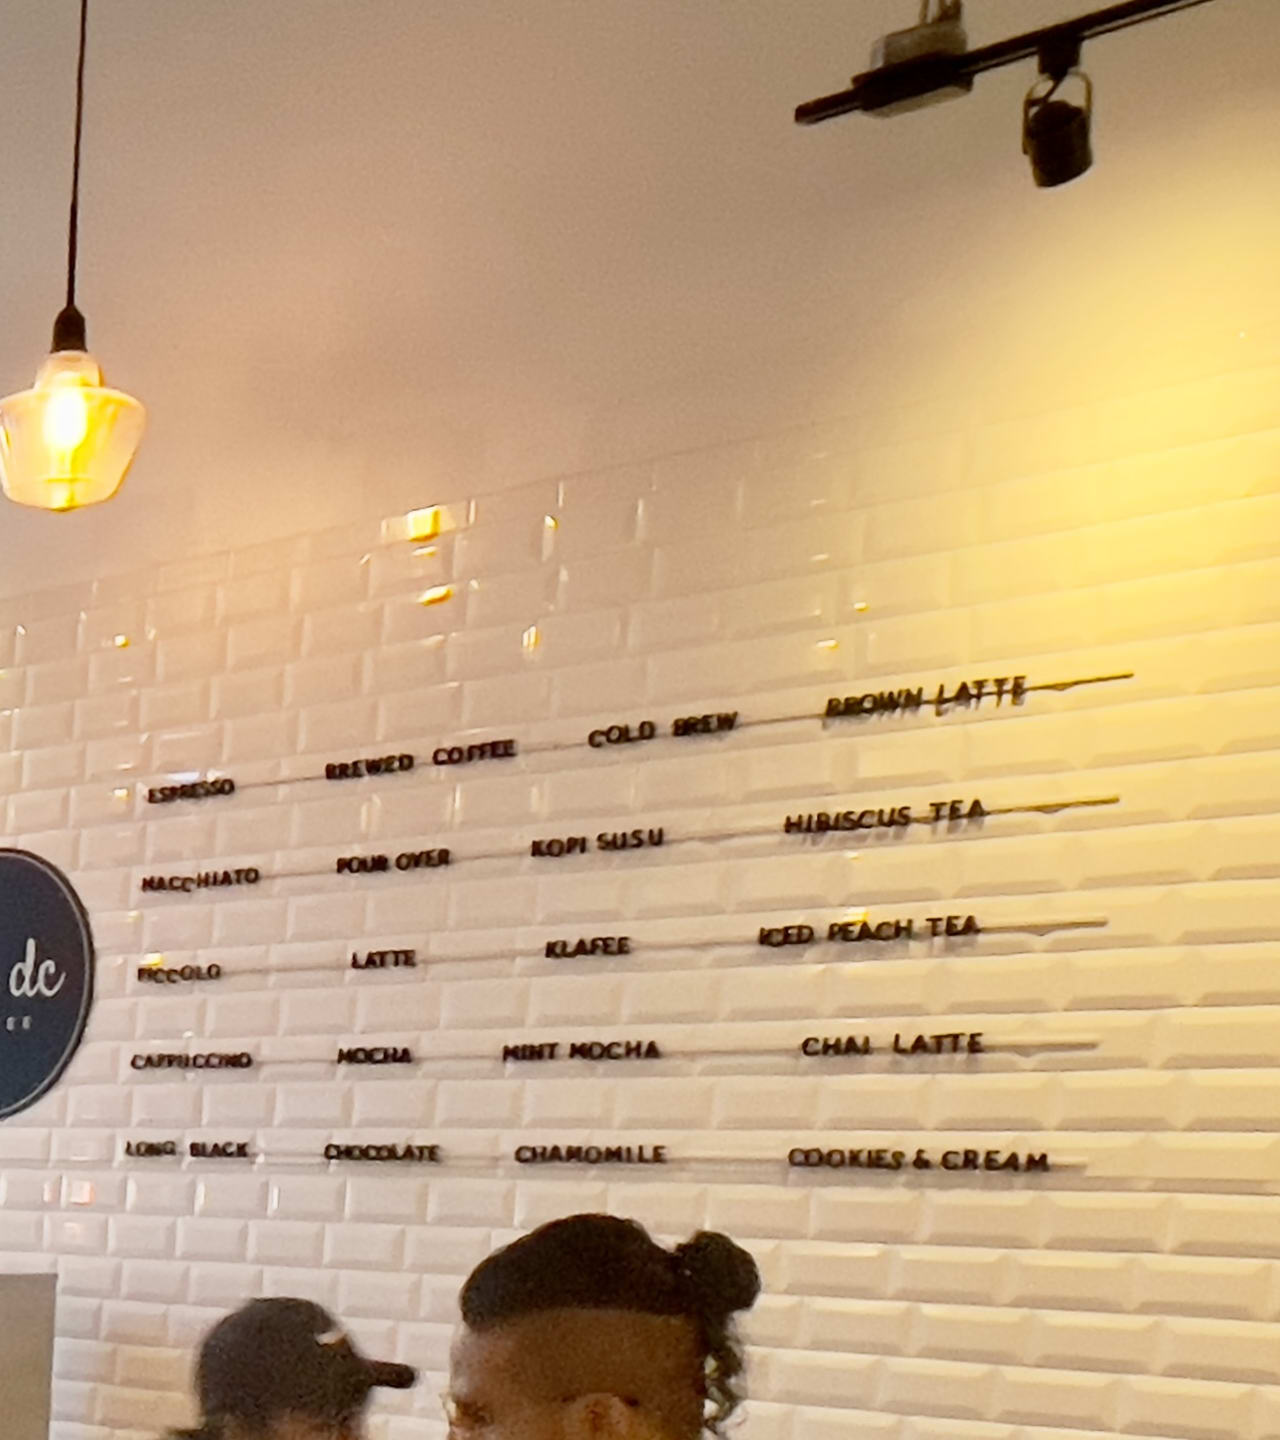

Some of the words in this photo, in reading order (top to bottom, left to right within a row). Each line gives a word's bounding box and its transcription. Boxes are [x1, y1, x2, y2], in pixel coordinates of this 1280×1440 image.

[824, 686, 923, 716] BROWN
[936, 675, 1027, 706] LATTE
[588, 720, 655, 748] COLD
[672, 711, 738, 737] BREW
[325, 753, 414, 780] BREWED
[432, 739, 517, 766] COFFEE
[147, 778, 236, 804] ESPRESSO
[784, 805, 911, 834] HIBISCUS
[929, 798, 986, 822] TEA
[531, 836, 587, 857] KOPI
[596, 827, 664, 851] SUSU
[336, 854, 389, 874] POUR
[395, 848, 451, 871] OVER
[141, 866, 260, 893] MACCHIATO
[758, 925, 815, 947] ICED
[827, 918, 913, 942] PEACH
[925, 914, 981, 937] TEA
[8, 937, 67, 998] dc
[351, 949, 418, 970] LATTE
[137, 963, 222, 984] PICCOLO
[337, 1046, 413, 1065] MOCHA
[502, 1042, 559, 1062] MINT
[568, 1040, 662, 1061] MOCHA
[802, 1035, 871, 1057] CHAI
[892, 1032, 985, 1055] LATTE
[130, 1051, 254, 1070] CAPPUCCINO
[126, 1140, 177, 1158] LONG
[189, 1141, 249, 1158] BLACK
[324, 1143, 441, 1163] CHOCOLATE
[514, 1144, 668, 1165] CHAMOMILE
[787, 1147, 906, 1170] COOKIES
[911, 1148, 932, 1170] &
[940, 1149, 1051, 1173] CREAM
